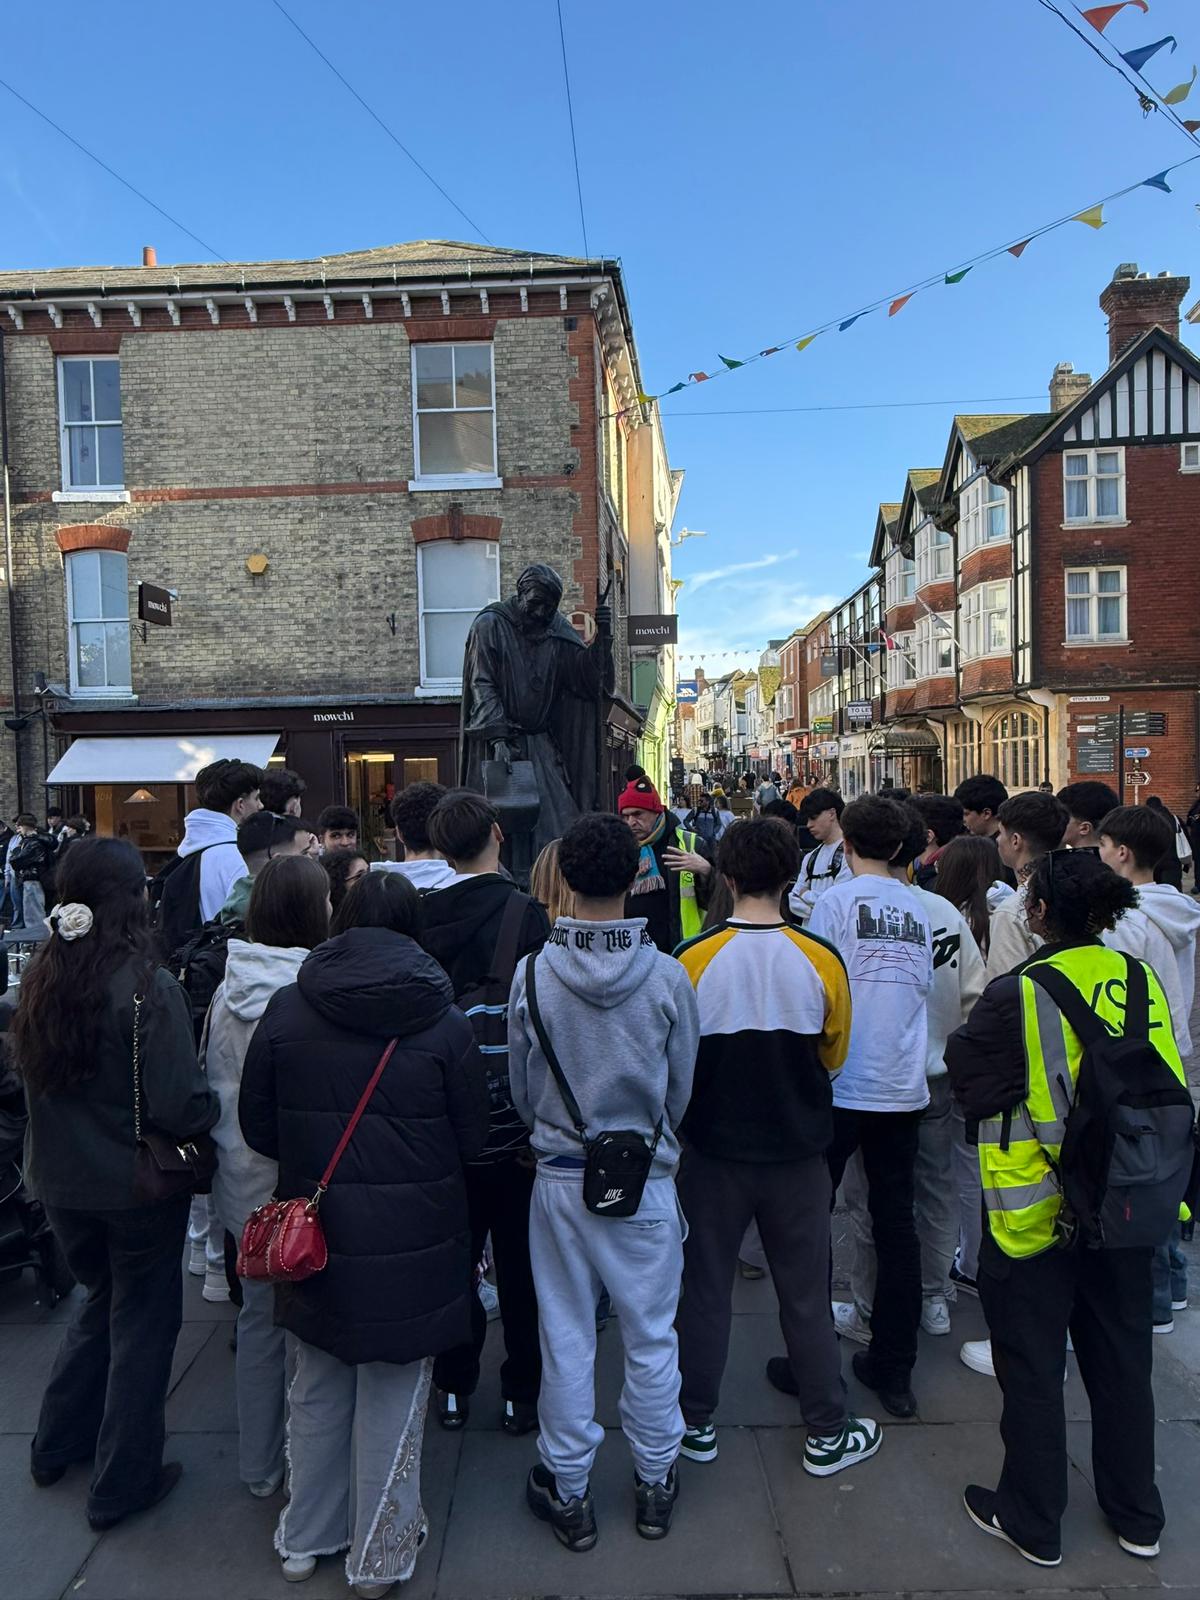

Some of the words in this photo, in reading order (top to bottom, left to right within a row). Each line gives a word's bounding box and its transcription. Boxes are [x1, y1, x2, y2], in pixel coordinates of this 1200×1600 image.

[313, 711, 355, 722] mowchi
[575, 931, 595, 951] OF
[602, 928, 632, 952] THE
